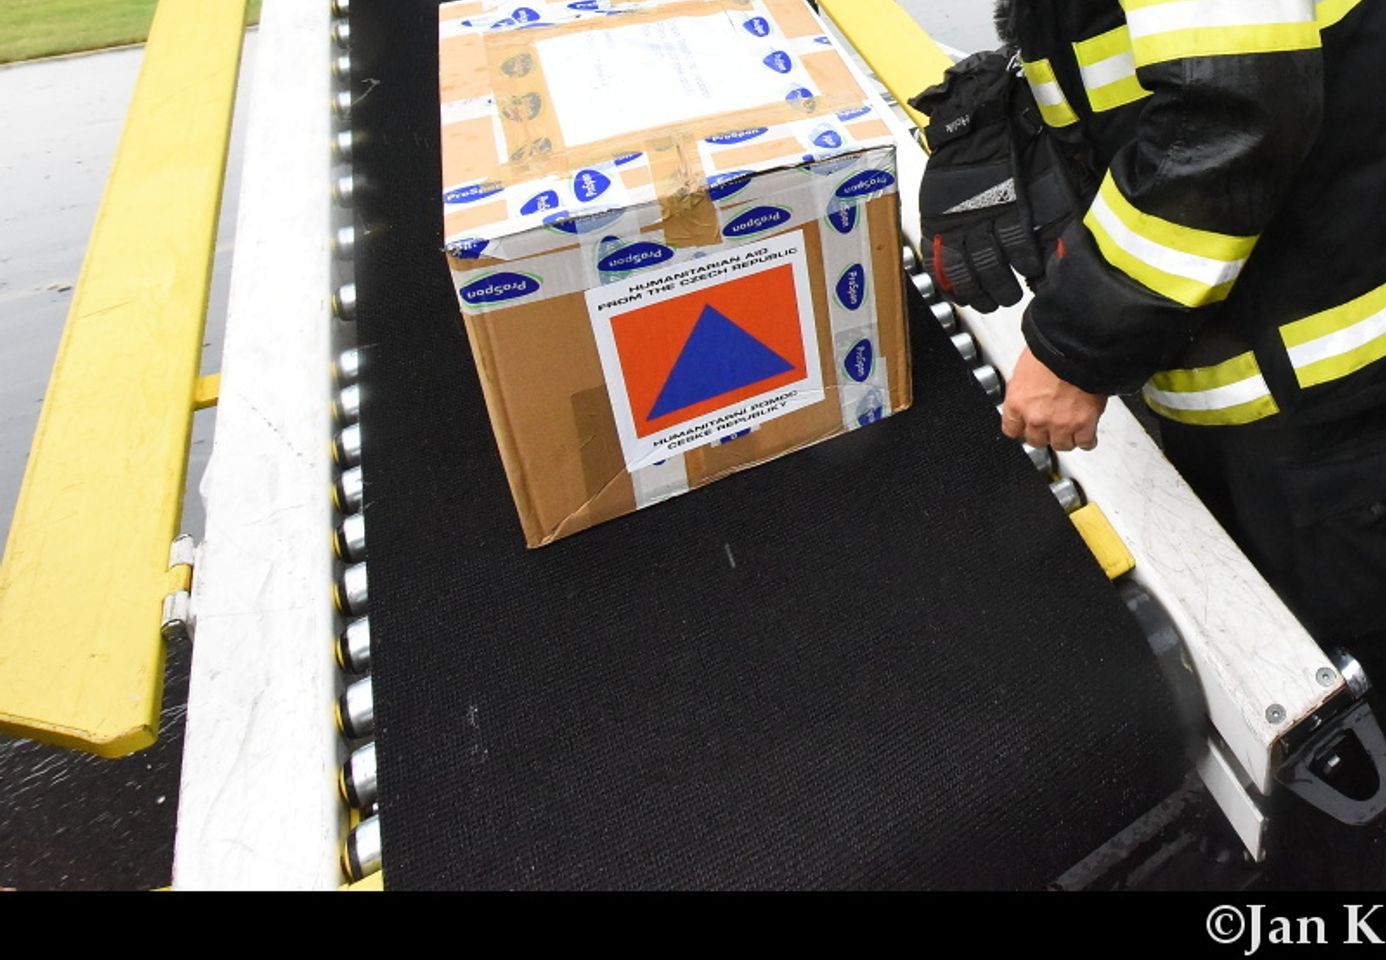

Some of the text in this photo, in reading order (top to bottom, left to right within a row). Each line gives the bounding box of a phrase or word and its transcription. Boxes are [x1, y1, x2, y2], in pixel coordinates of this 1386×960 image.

[843, 174, 888, 195] ProSpon
[732, 211, 781, 233] ProSpon
[608, 248, 663, 268] ProSpon
[597, 247, 798, 312] FROM THE CZECH REPUBLIC
[629, 247, 769, 293] HUMANITARIAN AID
[466, 280, 528, 300] ProSpon
[849, 271, 859, 305] ProSpon
[750, 390, 798, 411] POMOC
[716, 401, 787, 431] REPUBLIKY
